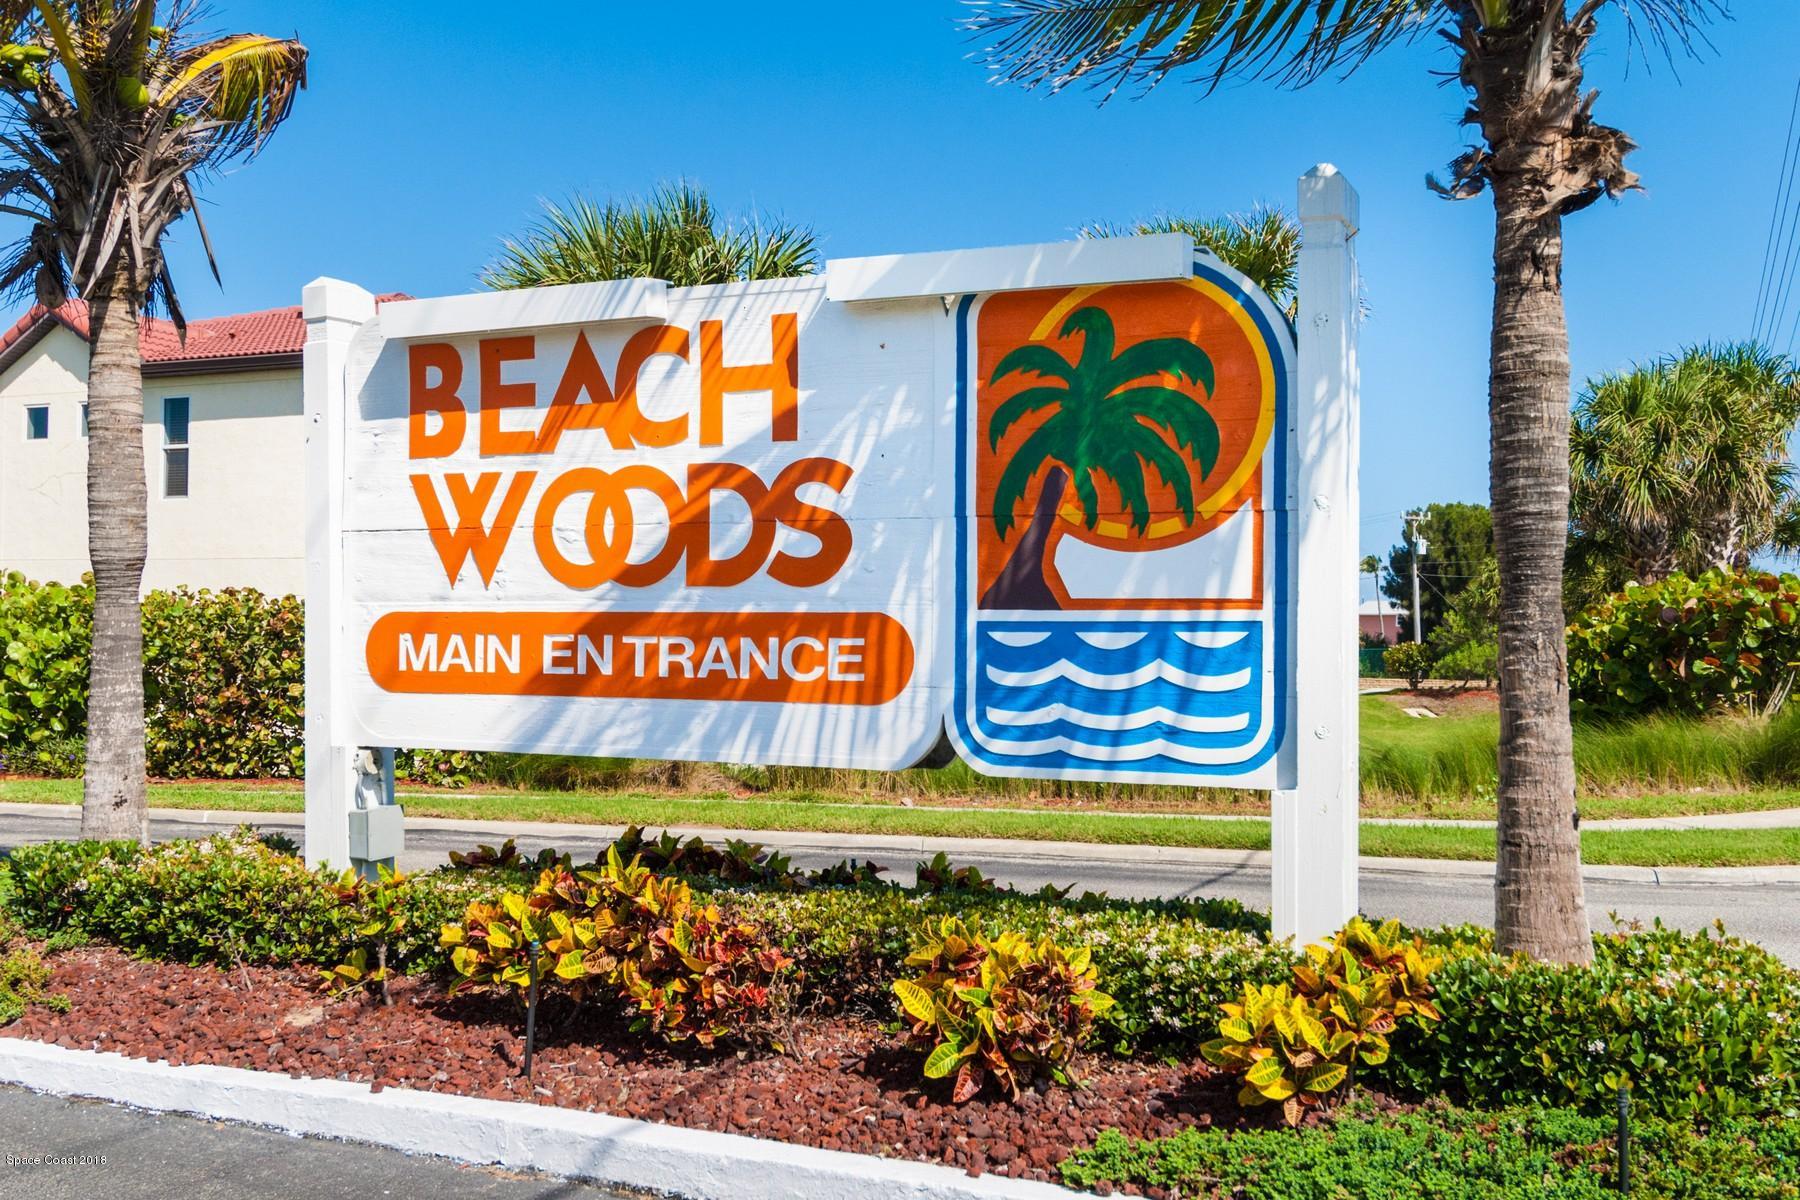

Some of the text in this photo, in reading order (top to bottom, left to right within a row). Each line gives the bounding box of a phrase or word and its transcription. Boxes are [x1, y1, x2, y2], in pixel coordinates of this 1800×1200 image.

[409, 312, 799, 460] BEACH
[410, 457, 854, 591] WOODS
[398, 632, 865, 683] MAIN ENTRANCE
